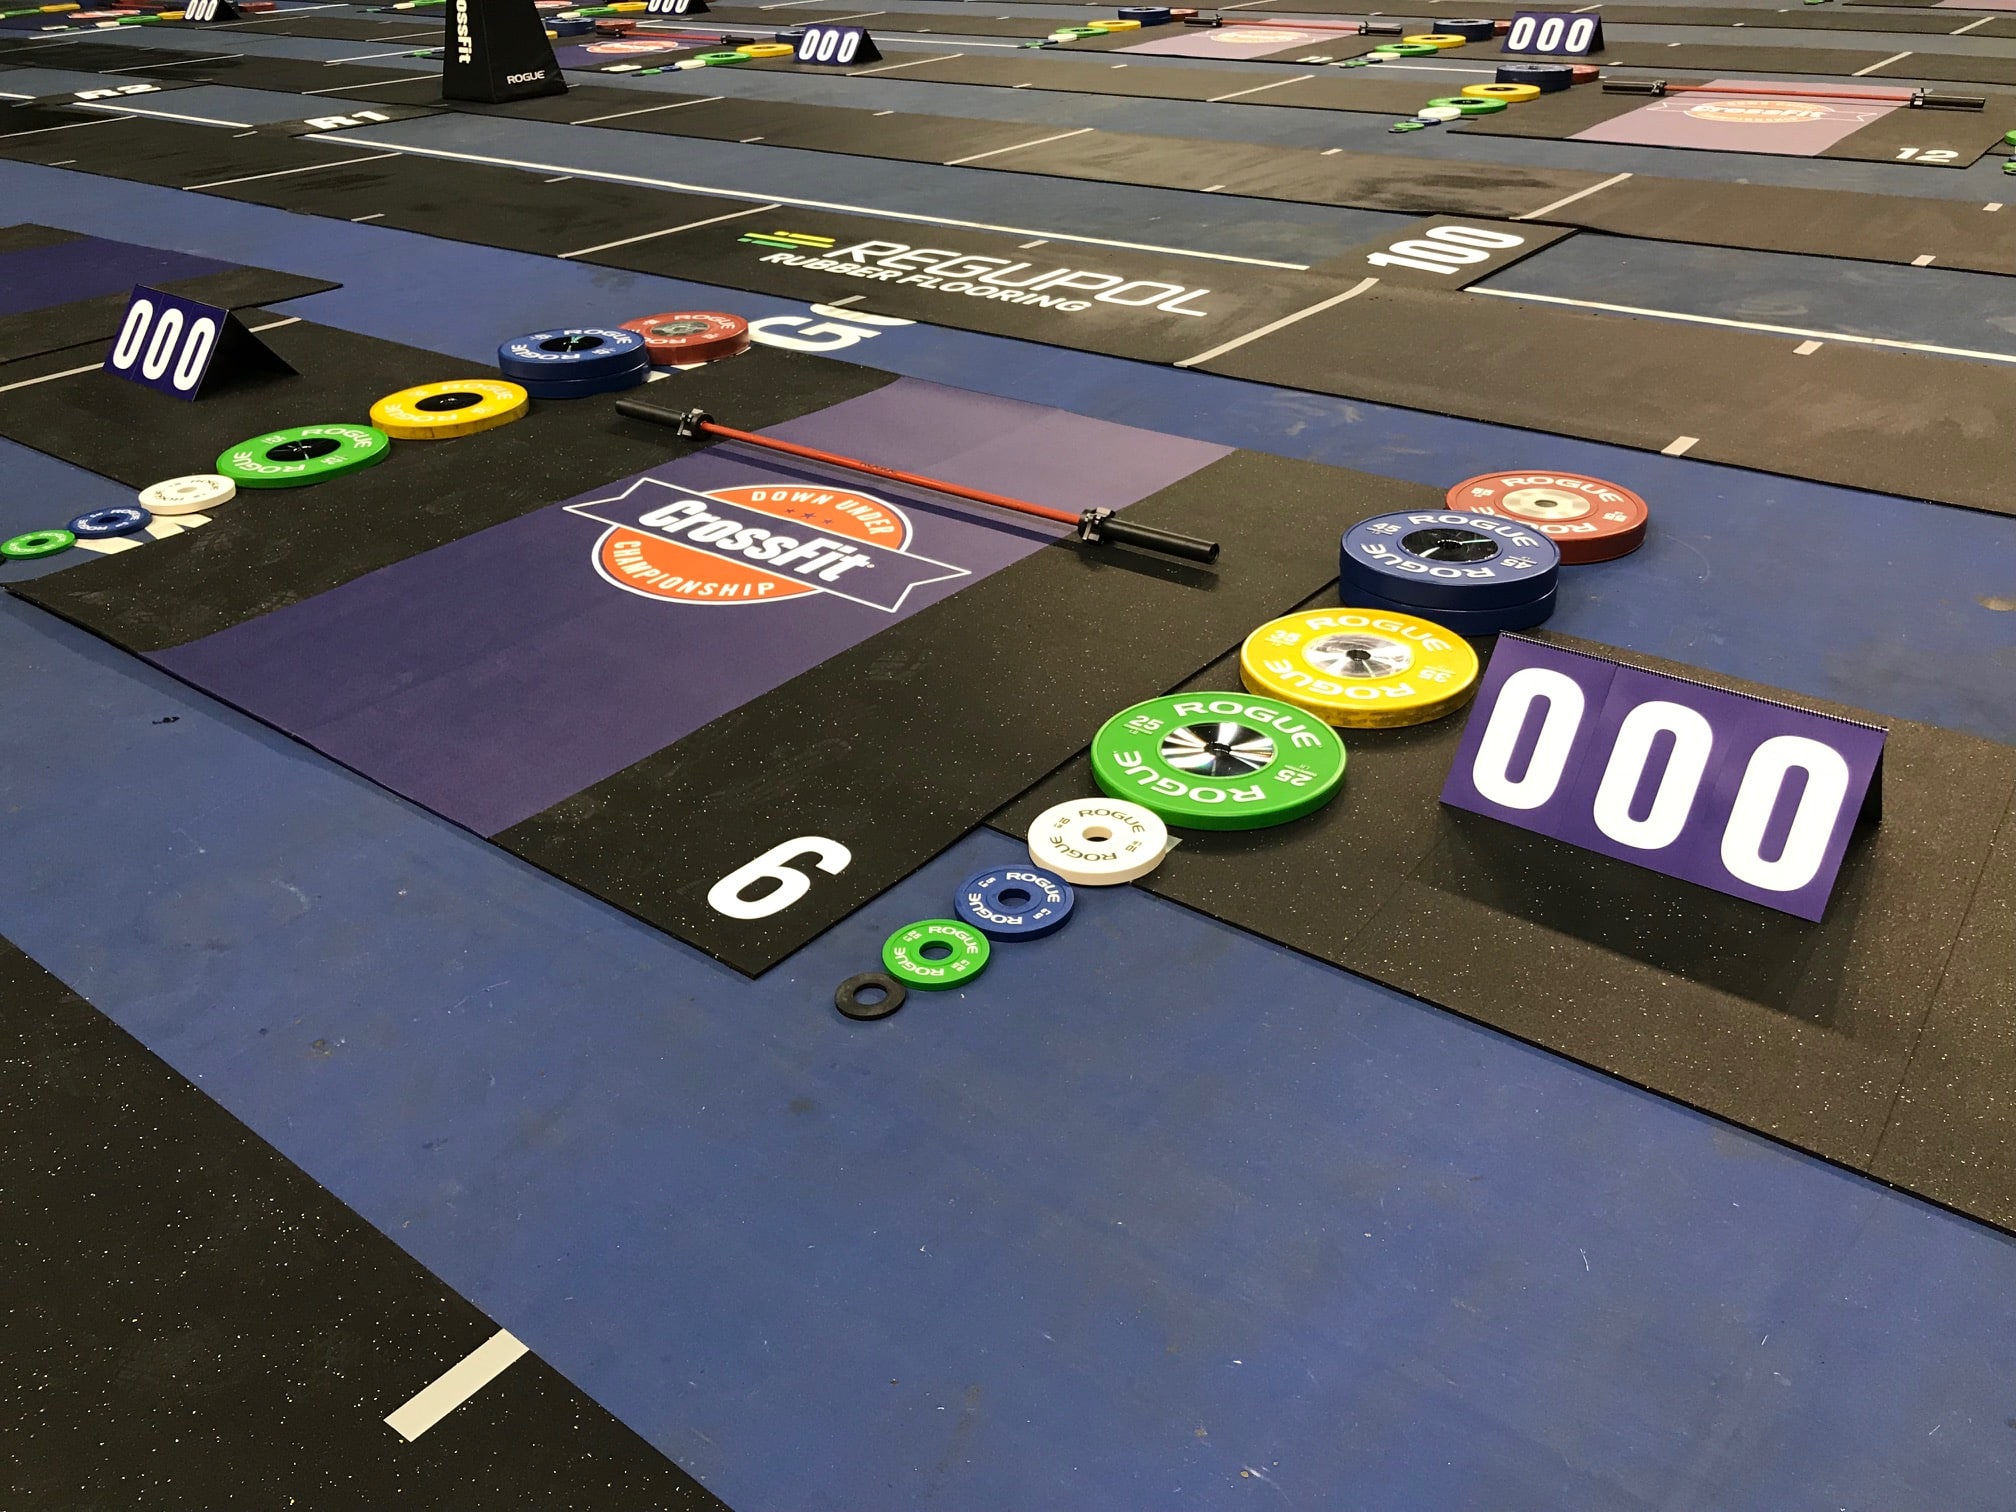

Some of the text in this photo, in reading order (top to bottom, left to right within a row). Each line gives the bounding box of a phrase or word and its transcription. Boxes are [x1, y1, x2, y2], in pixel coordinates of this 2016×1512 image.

[798, 29, 860, 63] 000
[1508, 17, 1593, 53] 000
[74, 84, 161, 99] R2
[506, 70, 546, 84] ROGUE
[304, 110, 390, 129] R1
[1896, 148, 1959, 163] 12
[1366, 226, 1525, 275] 100
[760, 253, 1092, 312] RUBBER FLOORING
[822, 240, 1210, 317] REGUPOL
[564, 329, 632, 344] ROGUE
[674, 314, 736, 329] ROGUE
[113, 299, 216, 391] 000
[511, 344, 580, 360] ROGUE
[301, 428, 373, 448] ROGUE
[233, 451, 306, 473] ROGUE
[1501, 476, 1625, 503] ROGUE
[751, 490, 896, 537] DOWN UNDER
[1372, 523, 1402, 532] 45
[638, 499, 870, 583] CrossFit
[1407, 515, 1540, 548] ROGUE
[613, 540, 775, 598] CHAMPIONSHIP
[1360, 543, 1496, 578] ROGUE
[1305, 615, 1452, 652] ROGUE
[1263, 658, 1417, 699] ROGUE
[1128, 715, 1164, 731] 25
[1172, 701, 1321, 749] ROGUE
[1112, 750, 1266, 803] ROGUE
[1274, 769, 1312, 786] 25
[1472, 668, 1849, 891] 000
[1058, 817, 1070, 825] 10
[1078, 808, 1146, 833] ROGUE
[1049, 835, 1117, 861] ROGUE
[708, 836, 852, 919] 6
[1005, 872, 1061, 903] ROGUE
[968, 893, 1023, 925] ROGUE
[928, 926, 978, 954] ROGUE
[894, 947, 944, 976] ROGUE
